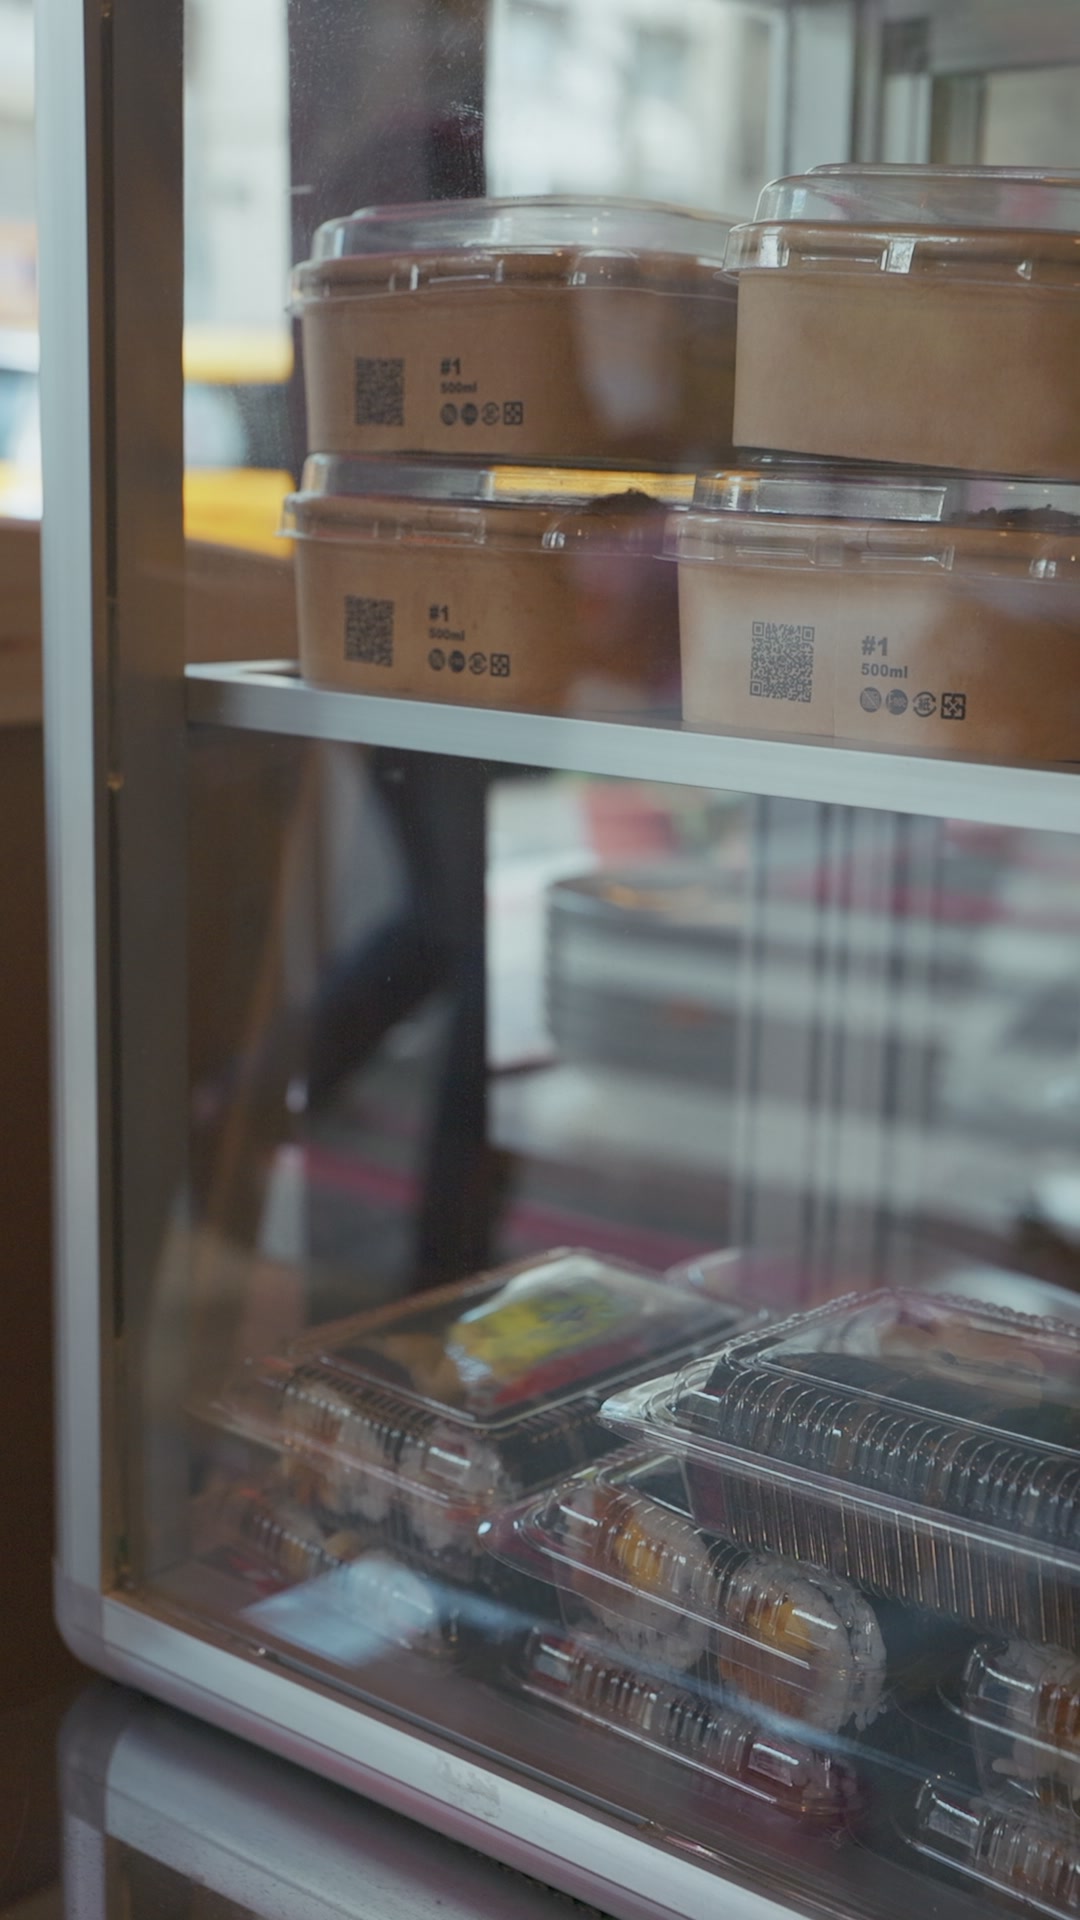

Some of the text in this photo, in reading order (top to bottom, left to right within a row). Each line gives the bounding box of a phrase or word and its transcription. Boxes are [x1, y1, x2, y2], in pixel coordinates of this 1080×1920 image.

[440, 358, 461, 375] #1
[440, 382, 477, 394] 500ml
[429, 605, 449, 622] #1
[428, 628, 465, 641] 500ml
[861, 635, 888, 657] #1
[861, 663, 908, 678] 500ml
